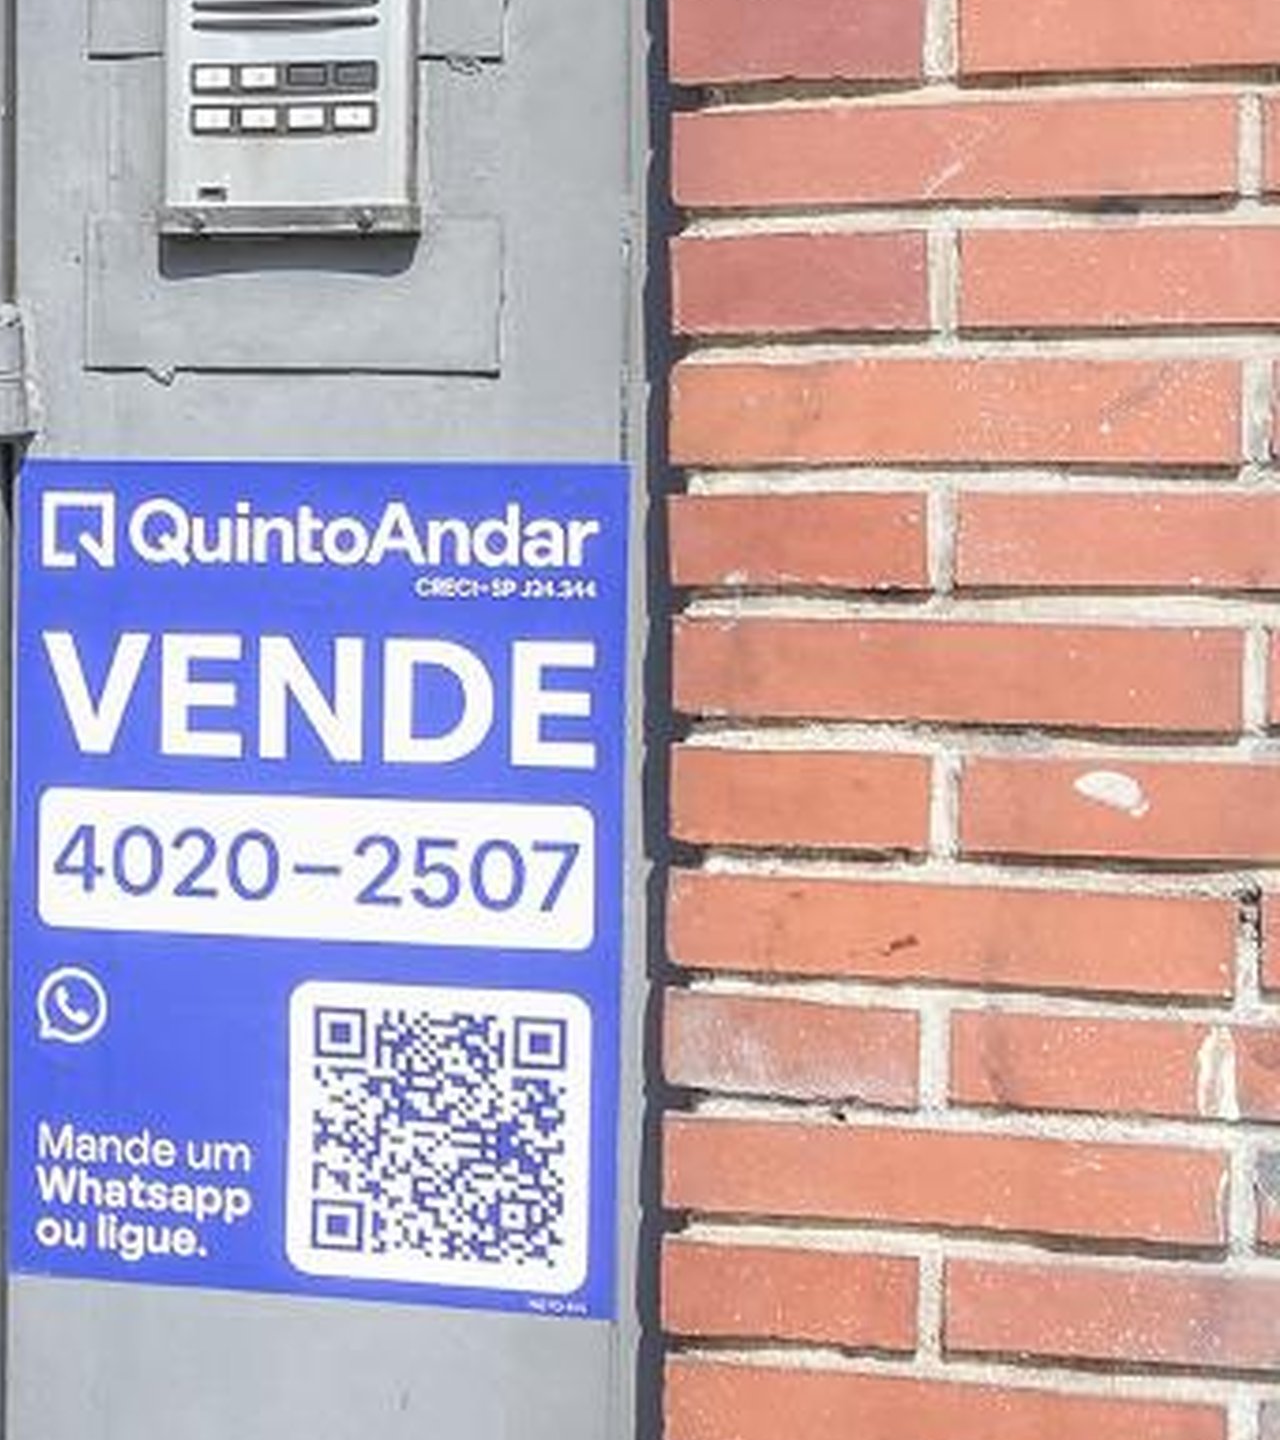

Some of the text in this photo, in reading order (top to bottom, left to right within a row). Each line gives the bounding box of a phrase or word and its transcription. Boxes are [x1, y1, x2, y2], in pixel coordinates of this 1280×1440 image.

[127, 497, 601, 569] QuintoAndar
[41, 630, 597, 770] VENDE
[52, 823, 582, 914] 4020-2507
[38, 1119, 252, 1173] Mande um
[35, 1164, 253, 1225] Whatsapp
[35, 1211, 209, 1262] ou ligue.
